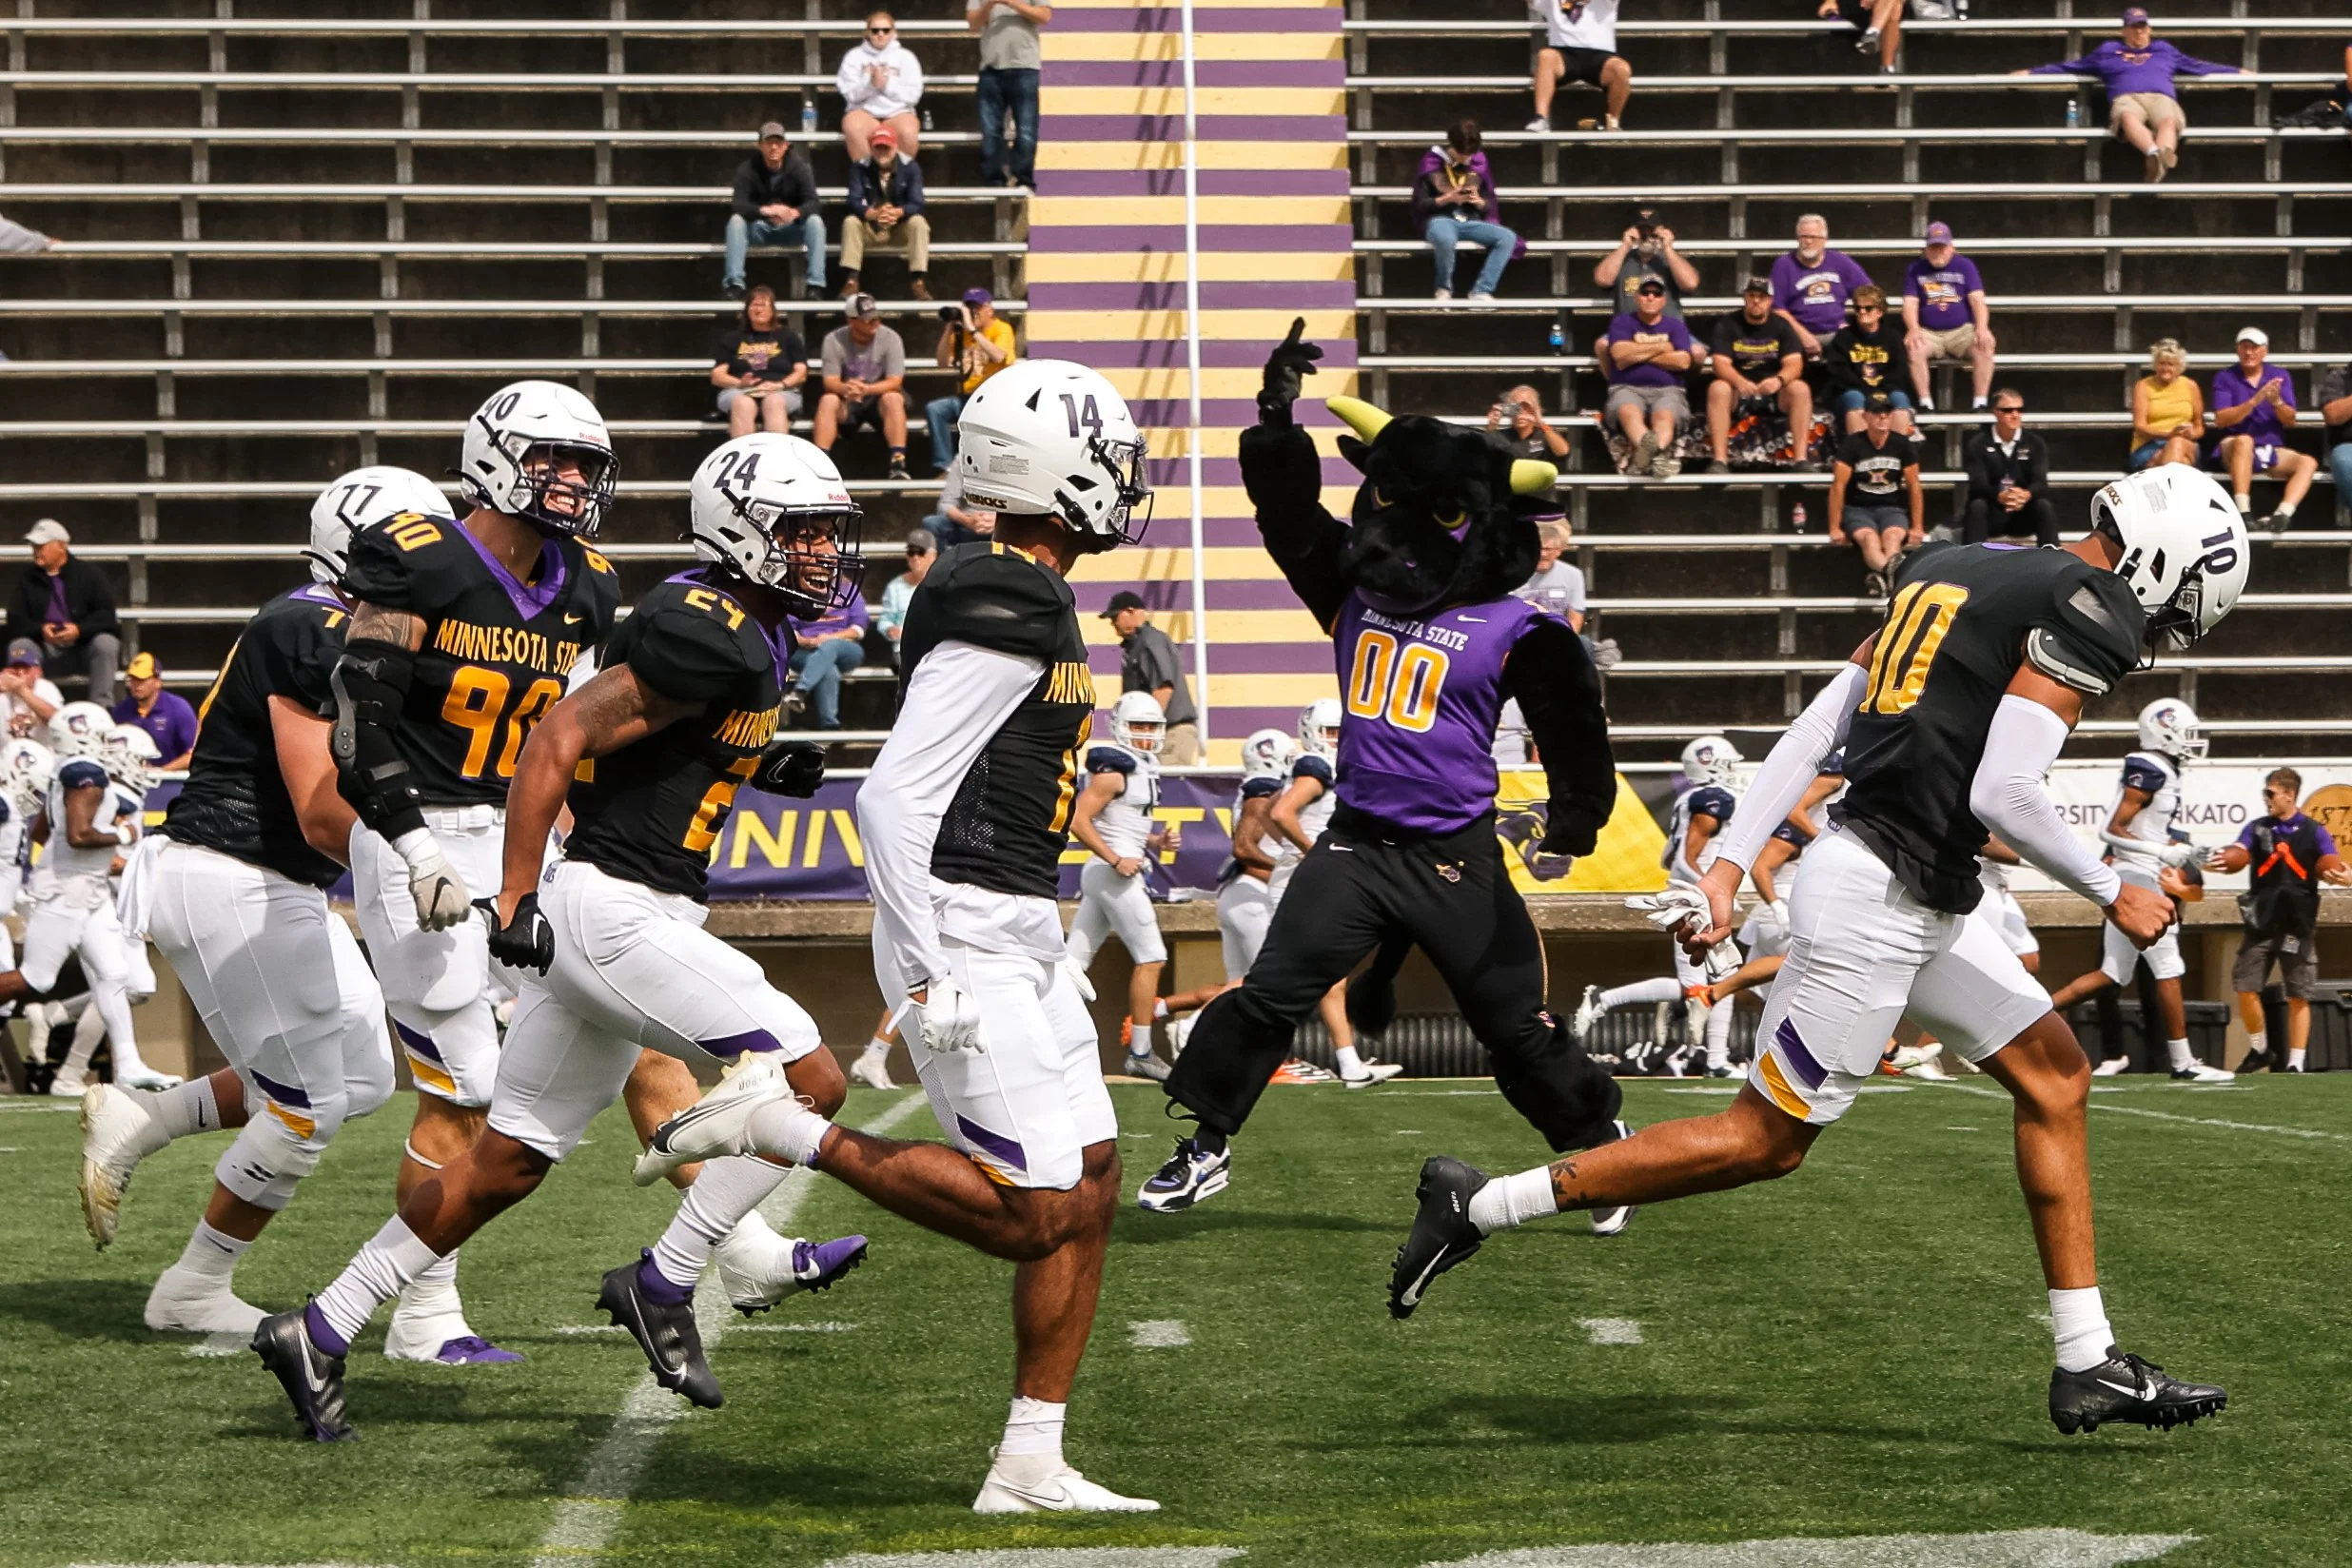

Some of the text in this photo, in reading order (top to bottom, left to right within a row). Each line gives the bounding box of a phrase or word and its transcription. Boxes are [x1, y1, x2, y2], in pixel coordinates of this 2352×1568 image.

[1059, 393, 1104, 438] 14
[714, 451, 761, 491] 24
[335, 483, 382, 516] 77
[2201, 525, 2238, 575] 10
[433, 617, 548, 673] MINNESOTA
[1361, 608, 1469, 651] MINNESOTA STATE
[1858, 580, 1970, 715] 10
[1347, 628, 1451, 734] 00
